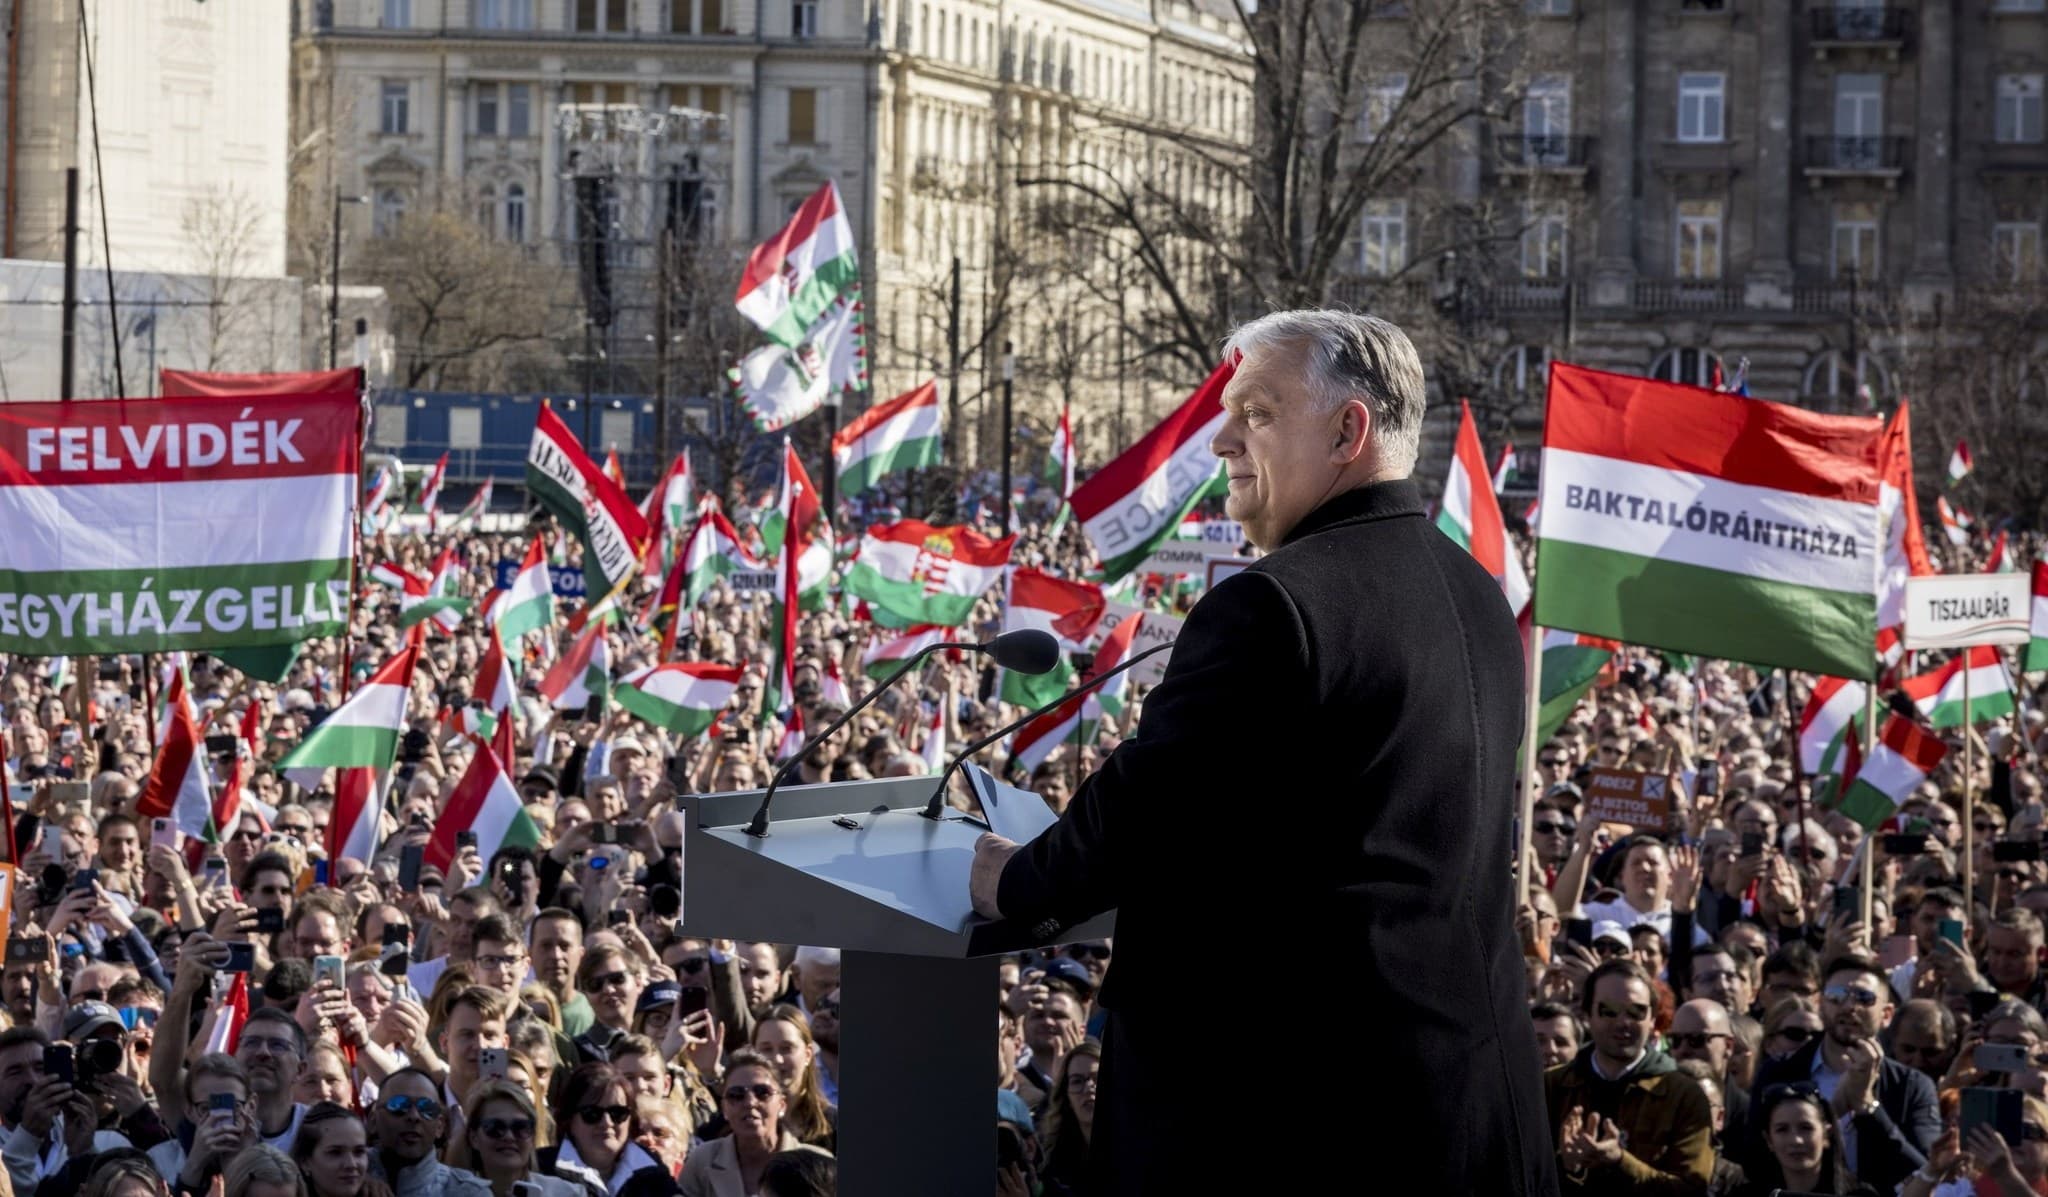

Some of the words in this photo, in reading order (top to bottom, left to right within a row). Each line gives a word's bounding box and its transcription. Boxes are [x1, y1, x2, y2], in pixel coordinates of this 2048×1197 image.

[26, 407, 304, 472] FELVIDÉK
[1565, 484, 1858, 560] BAKTALÓRÁNTHÁZA
[0, 577, 349, 639] EGYHÁZGELLE
[1928, 591, 2009, 621] TISZAALPÁR
